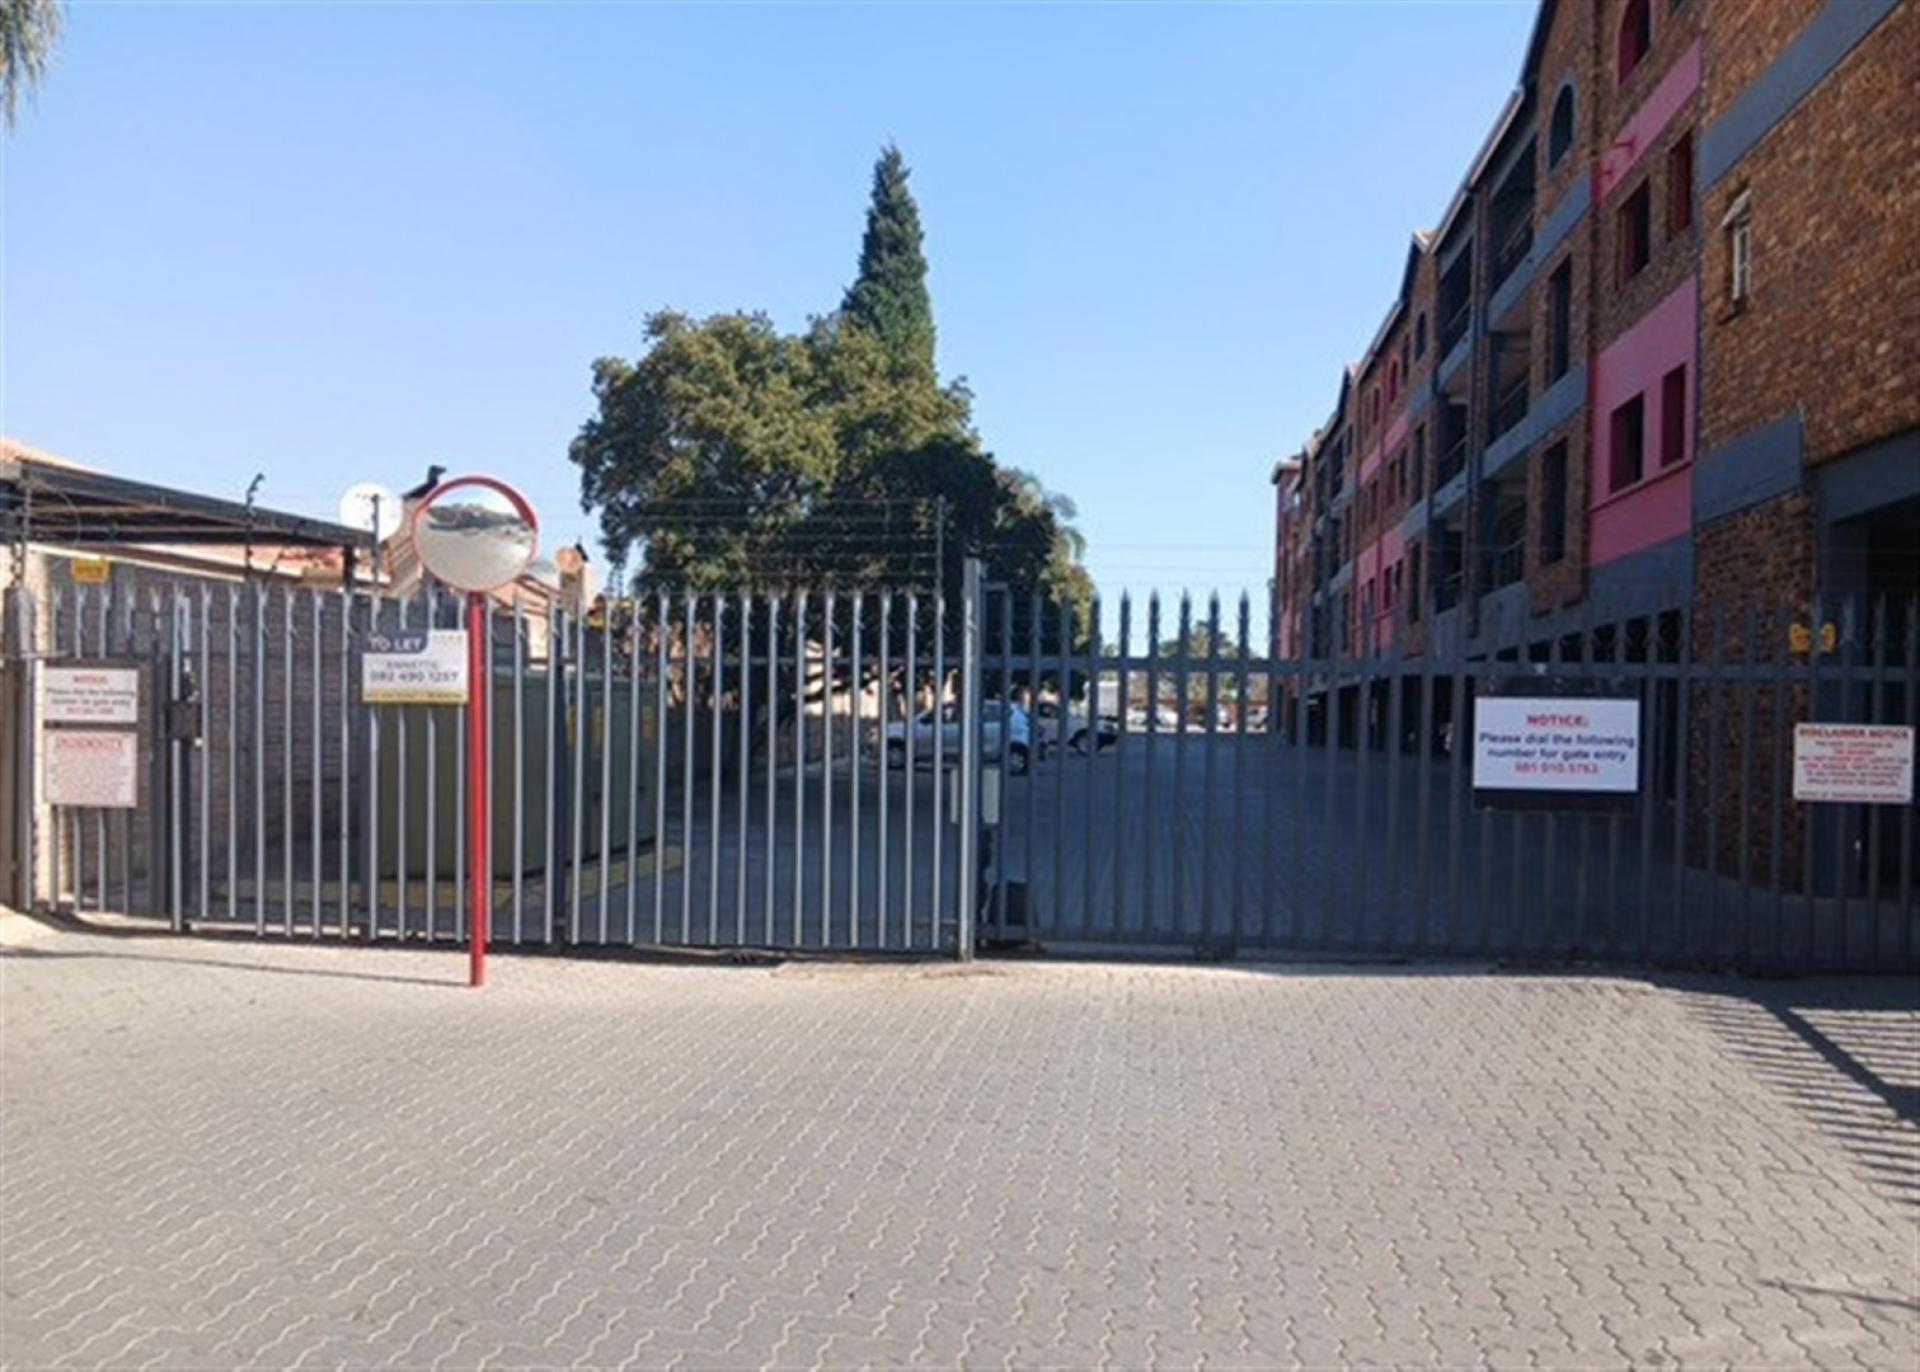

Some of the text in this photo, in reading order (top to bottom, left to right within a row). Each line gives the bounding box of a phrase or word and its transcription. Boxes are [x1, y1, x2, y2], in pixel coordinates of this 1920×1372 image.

[394, 637, 422, 652] LET
[1526, 714, 1589, 727] NOTICE:
[1479, 731, 1635, 749] Please dial the following
[1486, 747, 1626, 763] number for gate entry
